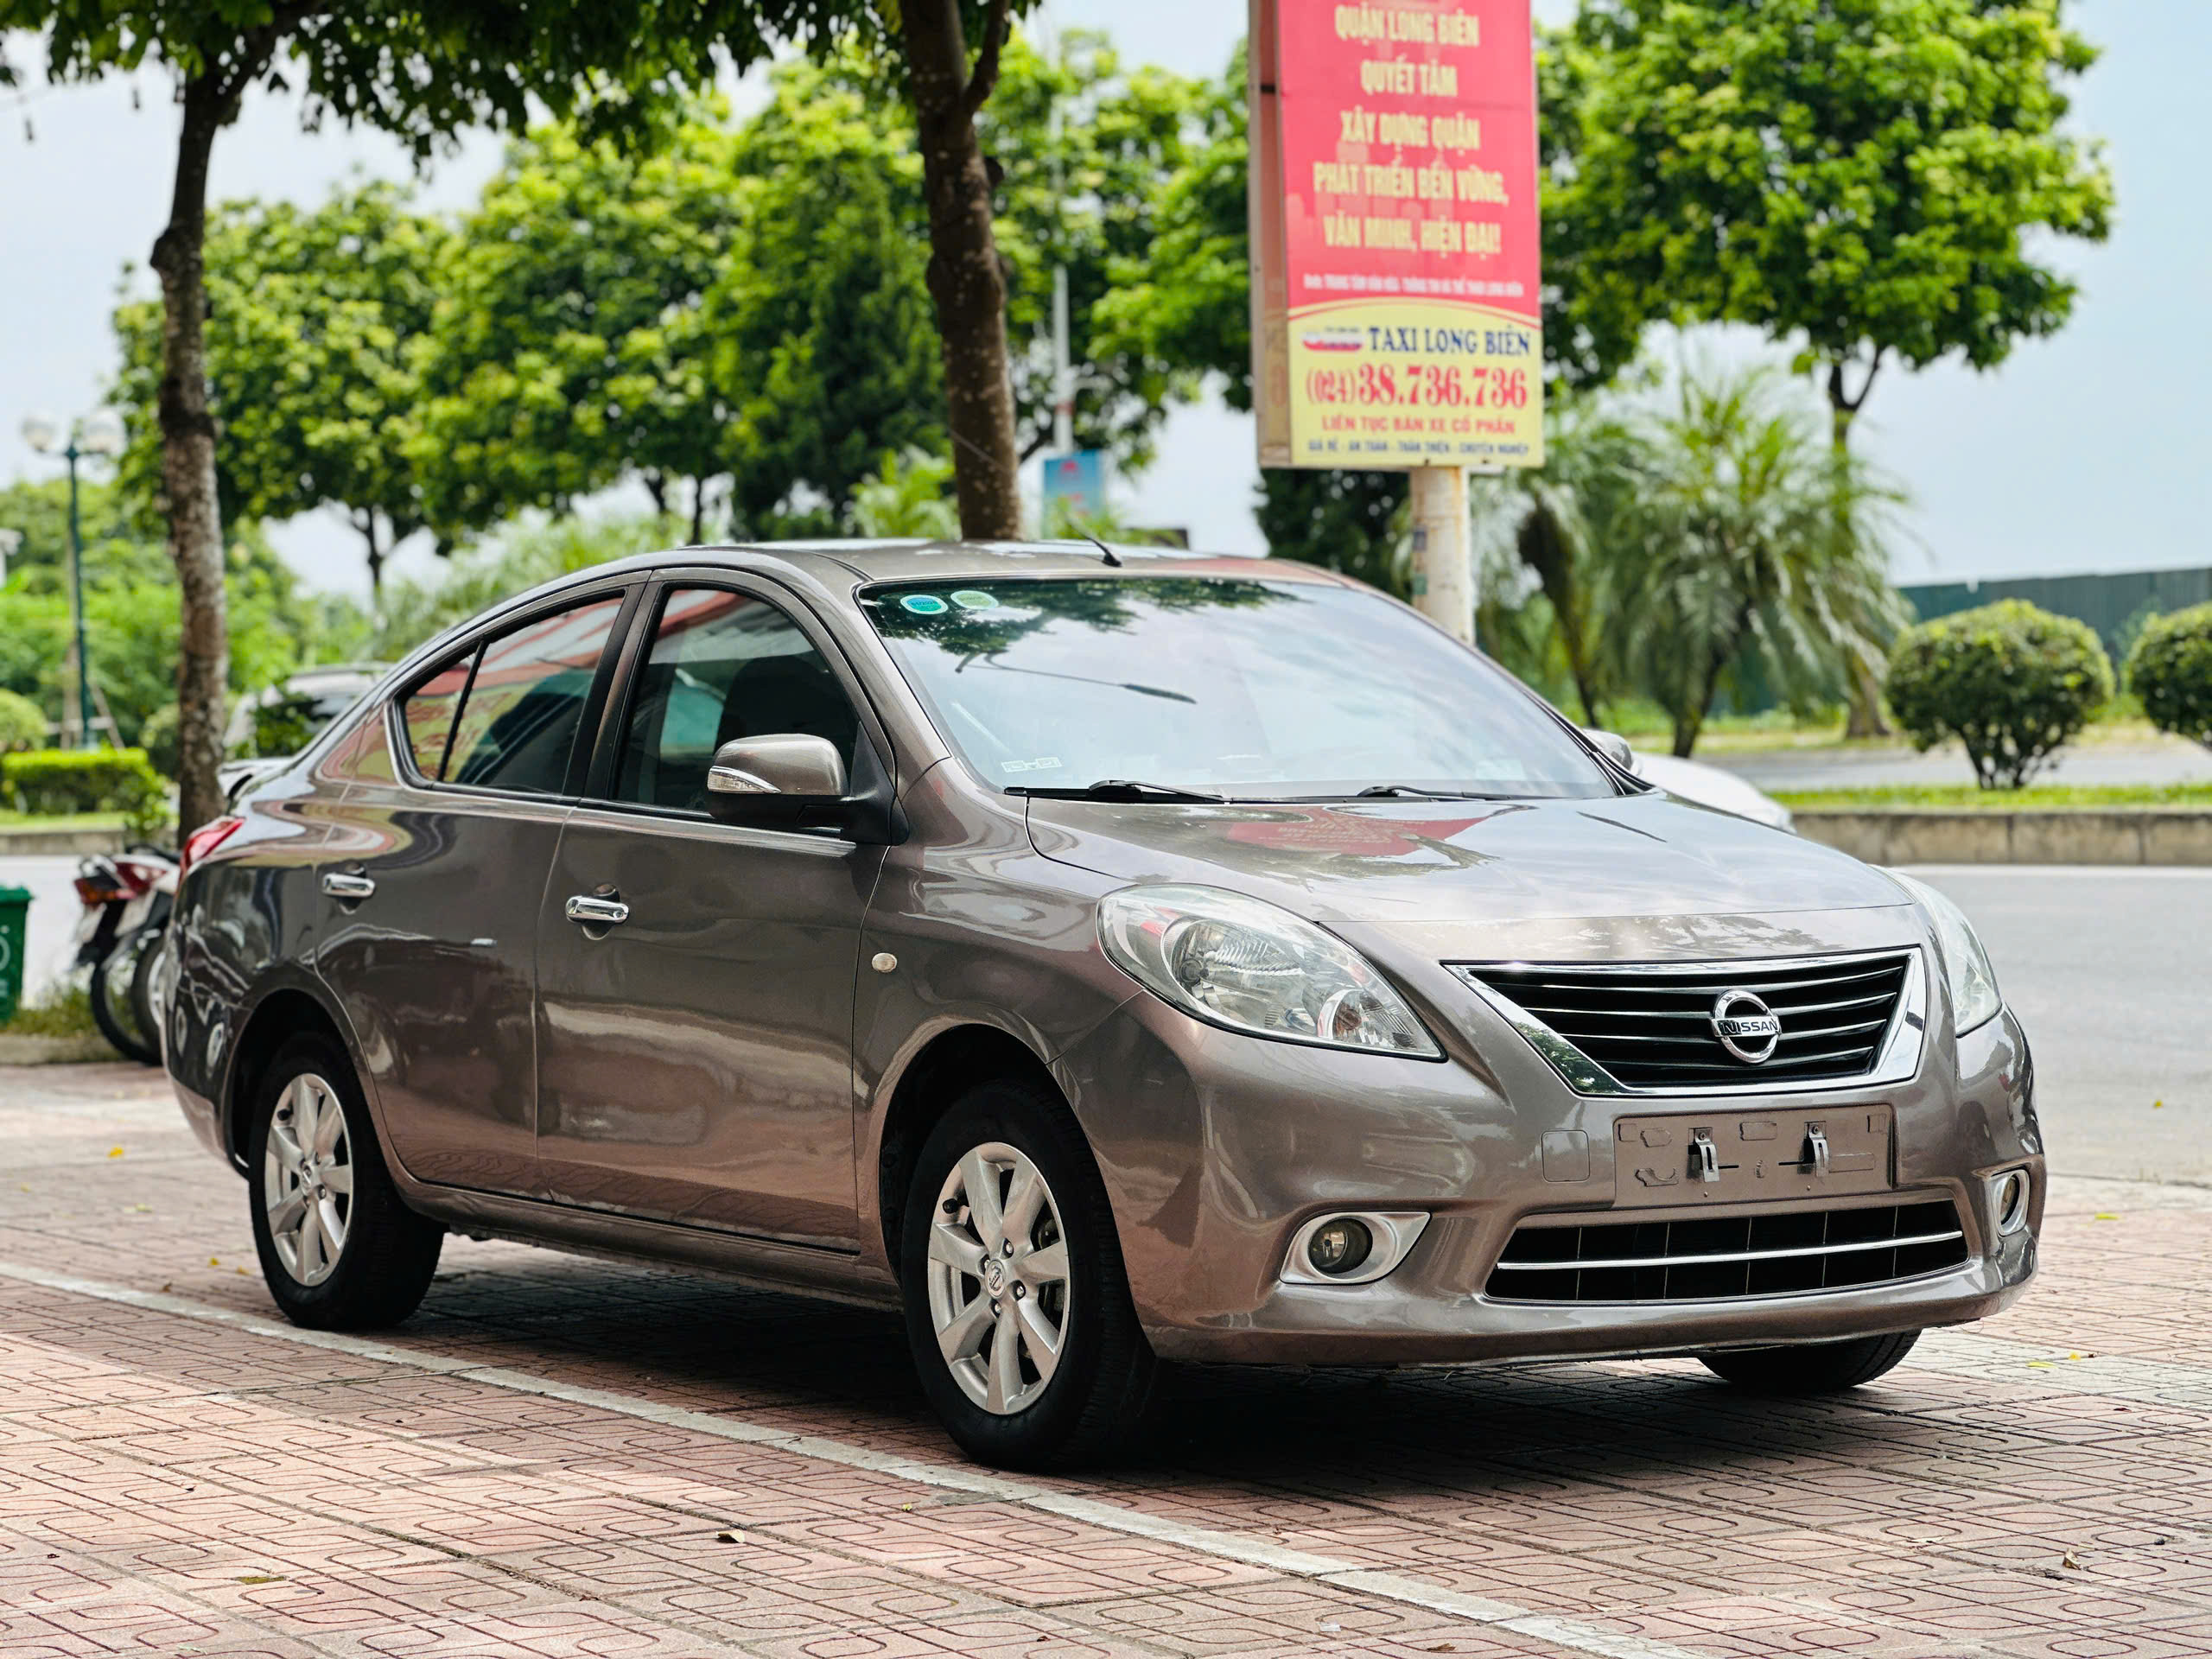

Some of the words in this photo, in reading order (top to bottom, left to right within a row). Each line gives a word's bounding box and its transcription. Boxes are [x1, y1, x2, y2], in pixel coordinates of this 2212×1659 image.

[1368, 326, 1417, 353] TAXI
[1425, 327, 1478, 354] LONG
[1721, 1020, 1778, 1035] NISSAN
